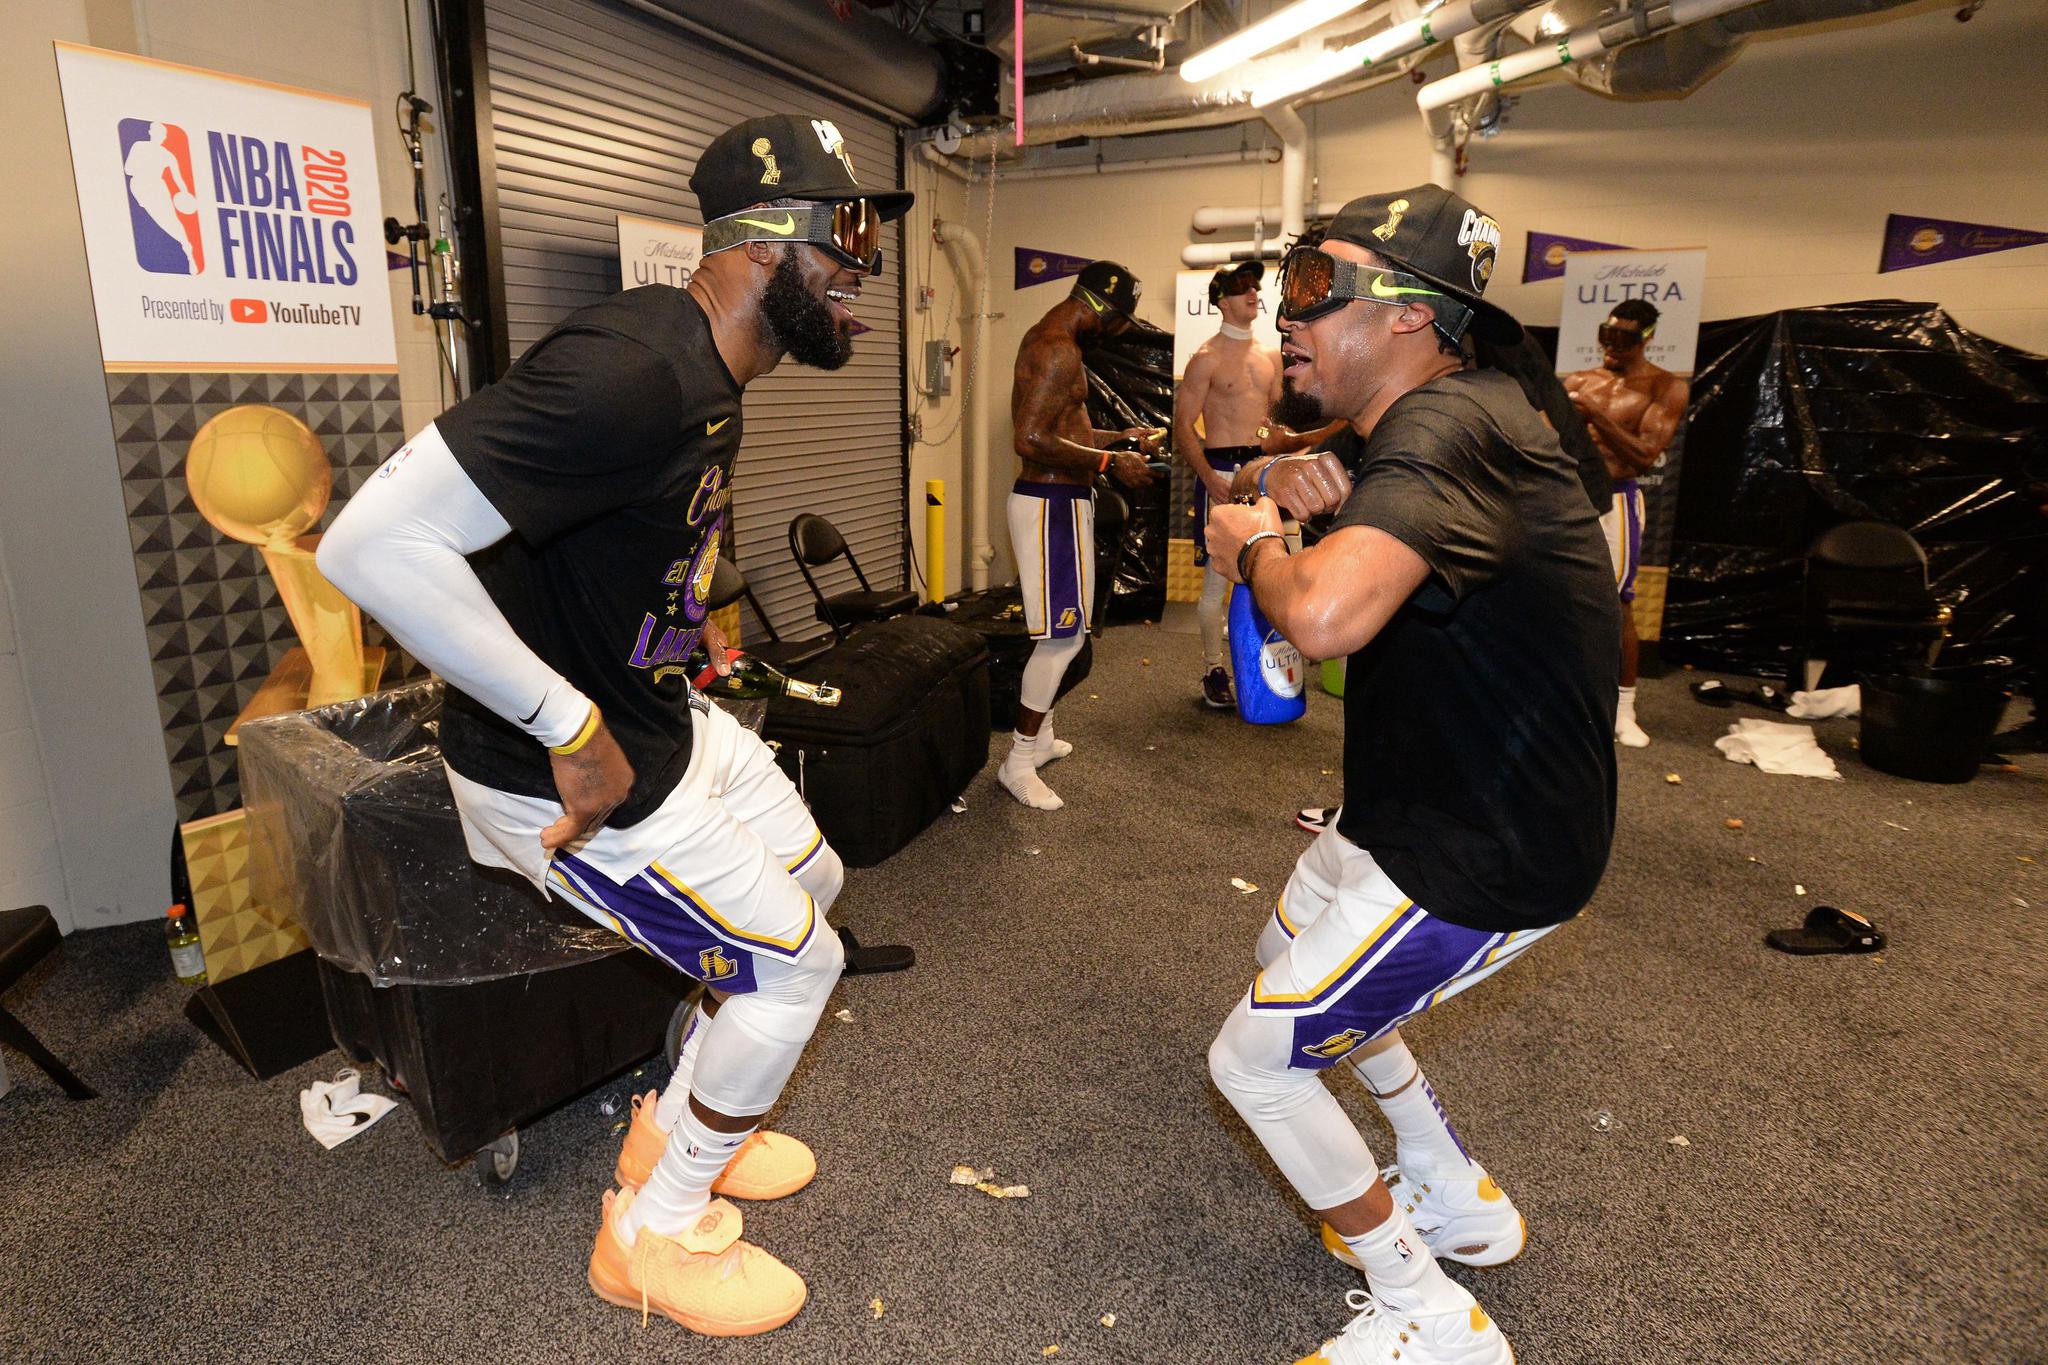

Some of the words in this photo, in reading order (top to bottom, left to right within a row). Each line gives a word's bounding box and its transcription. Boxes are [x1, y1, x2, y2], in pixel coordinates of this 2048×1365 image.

[207, 130, 302, 212] NBA
[302, 145, 352, 218] 2020
[217, 207, 358, 286] FINALS
[633, 260, 693, 289] ULTR
[141, 295, 208, 321] Presented
[210, 298, 224, 324] by
[1577, 281, 1683, 304] ULTRA
[627, 611, 703, 670] LAKE
